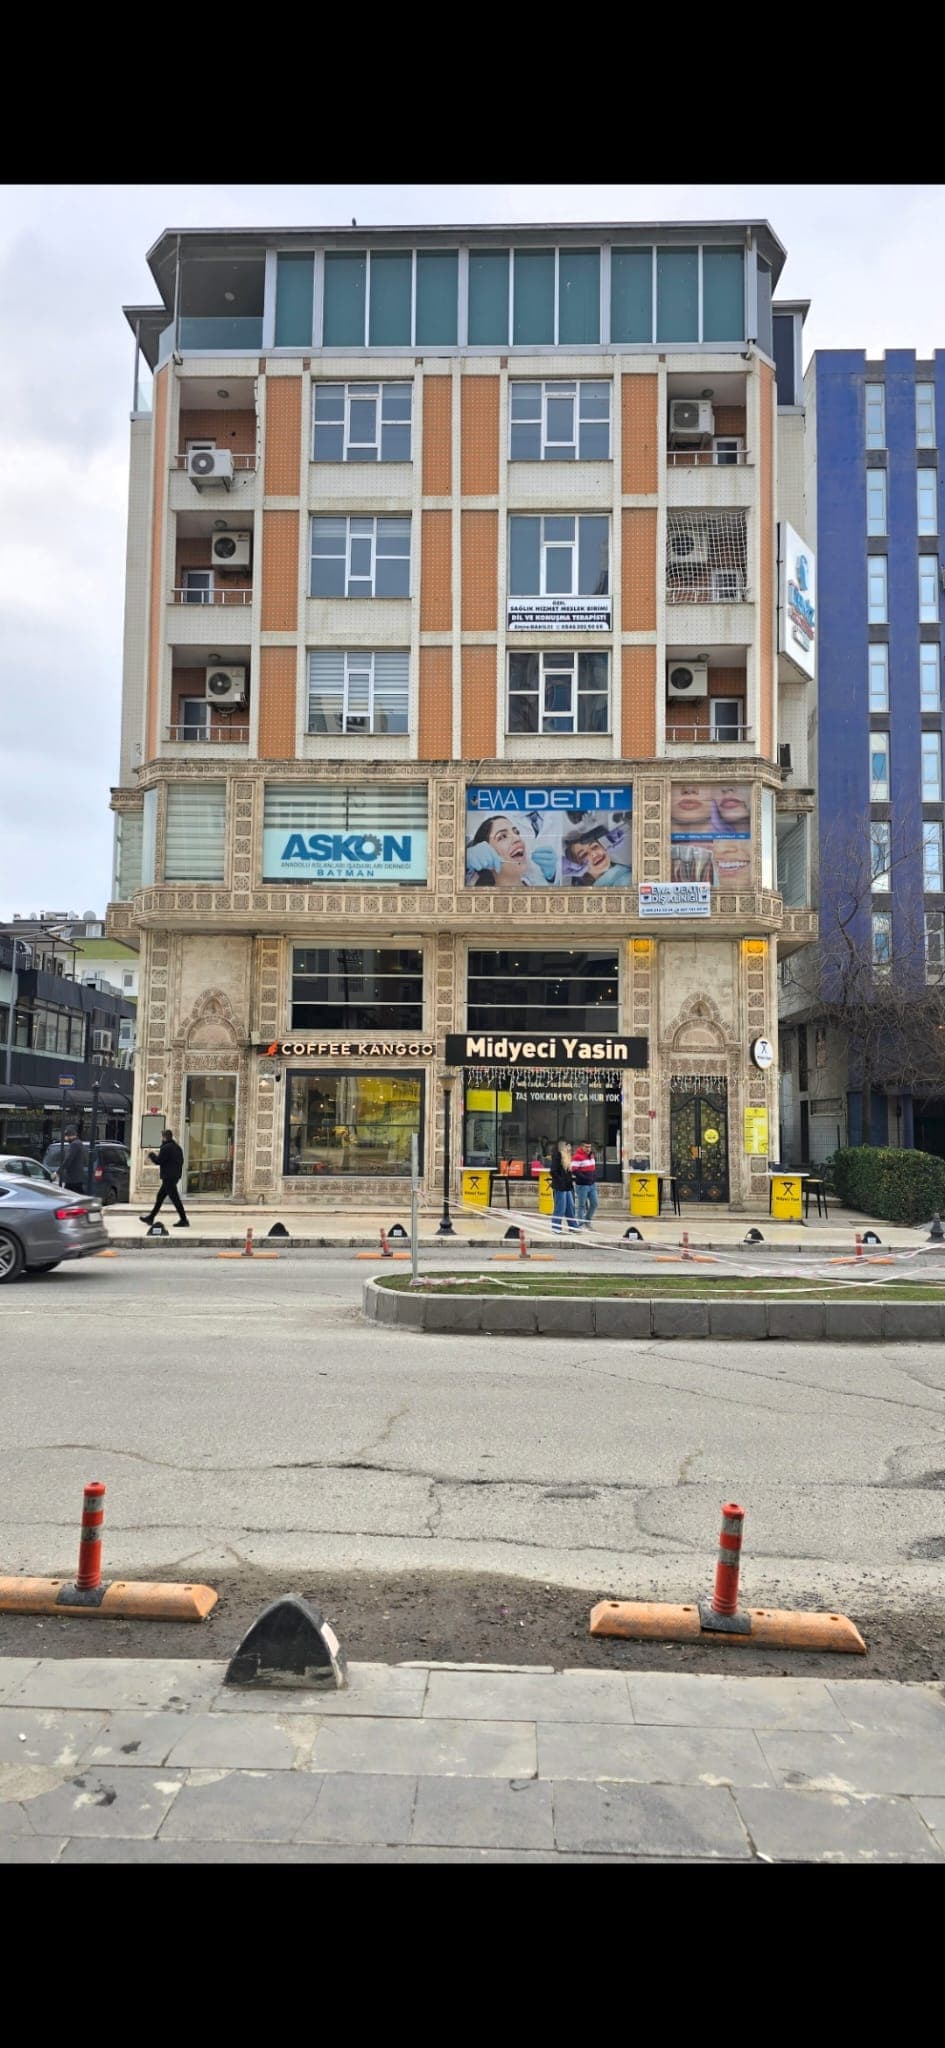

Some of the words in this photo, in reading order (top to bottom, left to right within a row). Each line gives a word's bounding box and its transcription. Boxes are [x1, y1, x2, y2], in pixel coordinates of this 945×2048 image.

[535, 614, 571, 622] KONUŞMA
[525, 789, 624, 809] DENT
[281, 833, 412, 862] ASKON
[281, 1043, 351, 1055] COFFEE
[359, 1043, 433, 1055] KANGOO
[466, 1037, 556, 1062] Midyeci
[562, 1038, 628, 1060] Yasin
[530, 1092, 545, 1100] YOK
